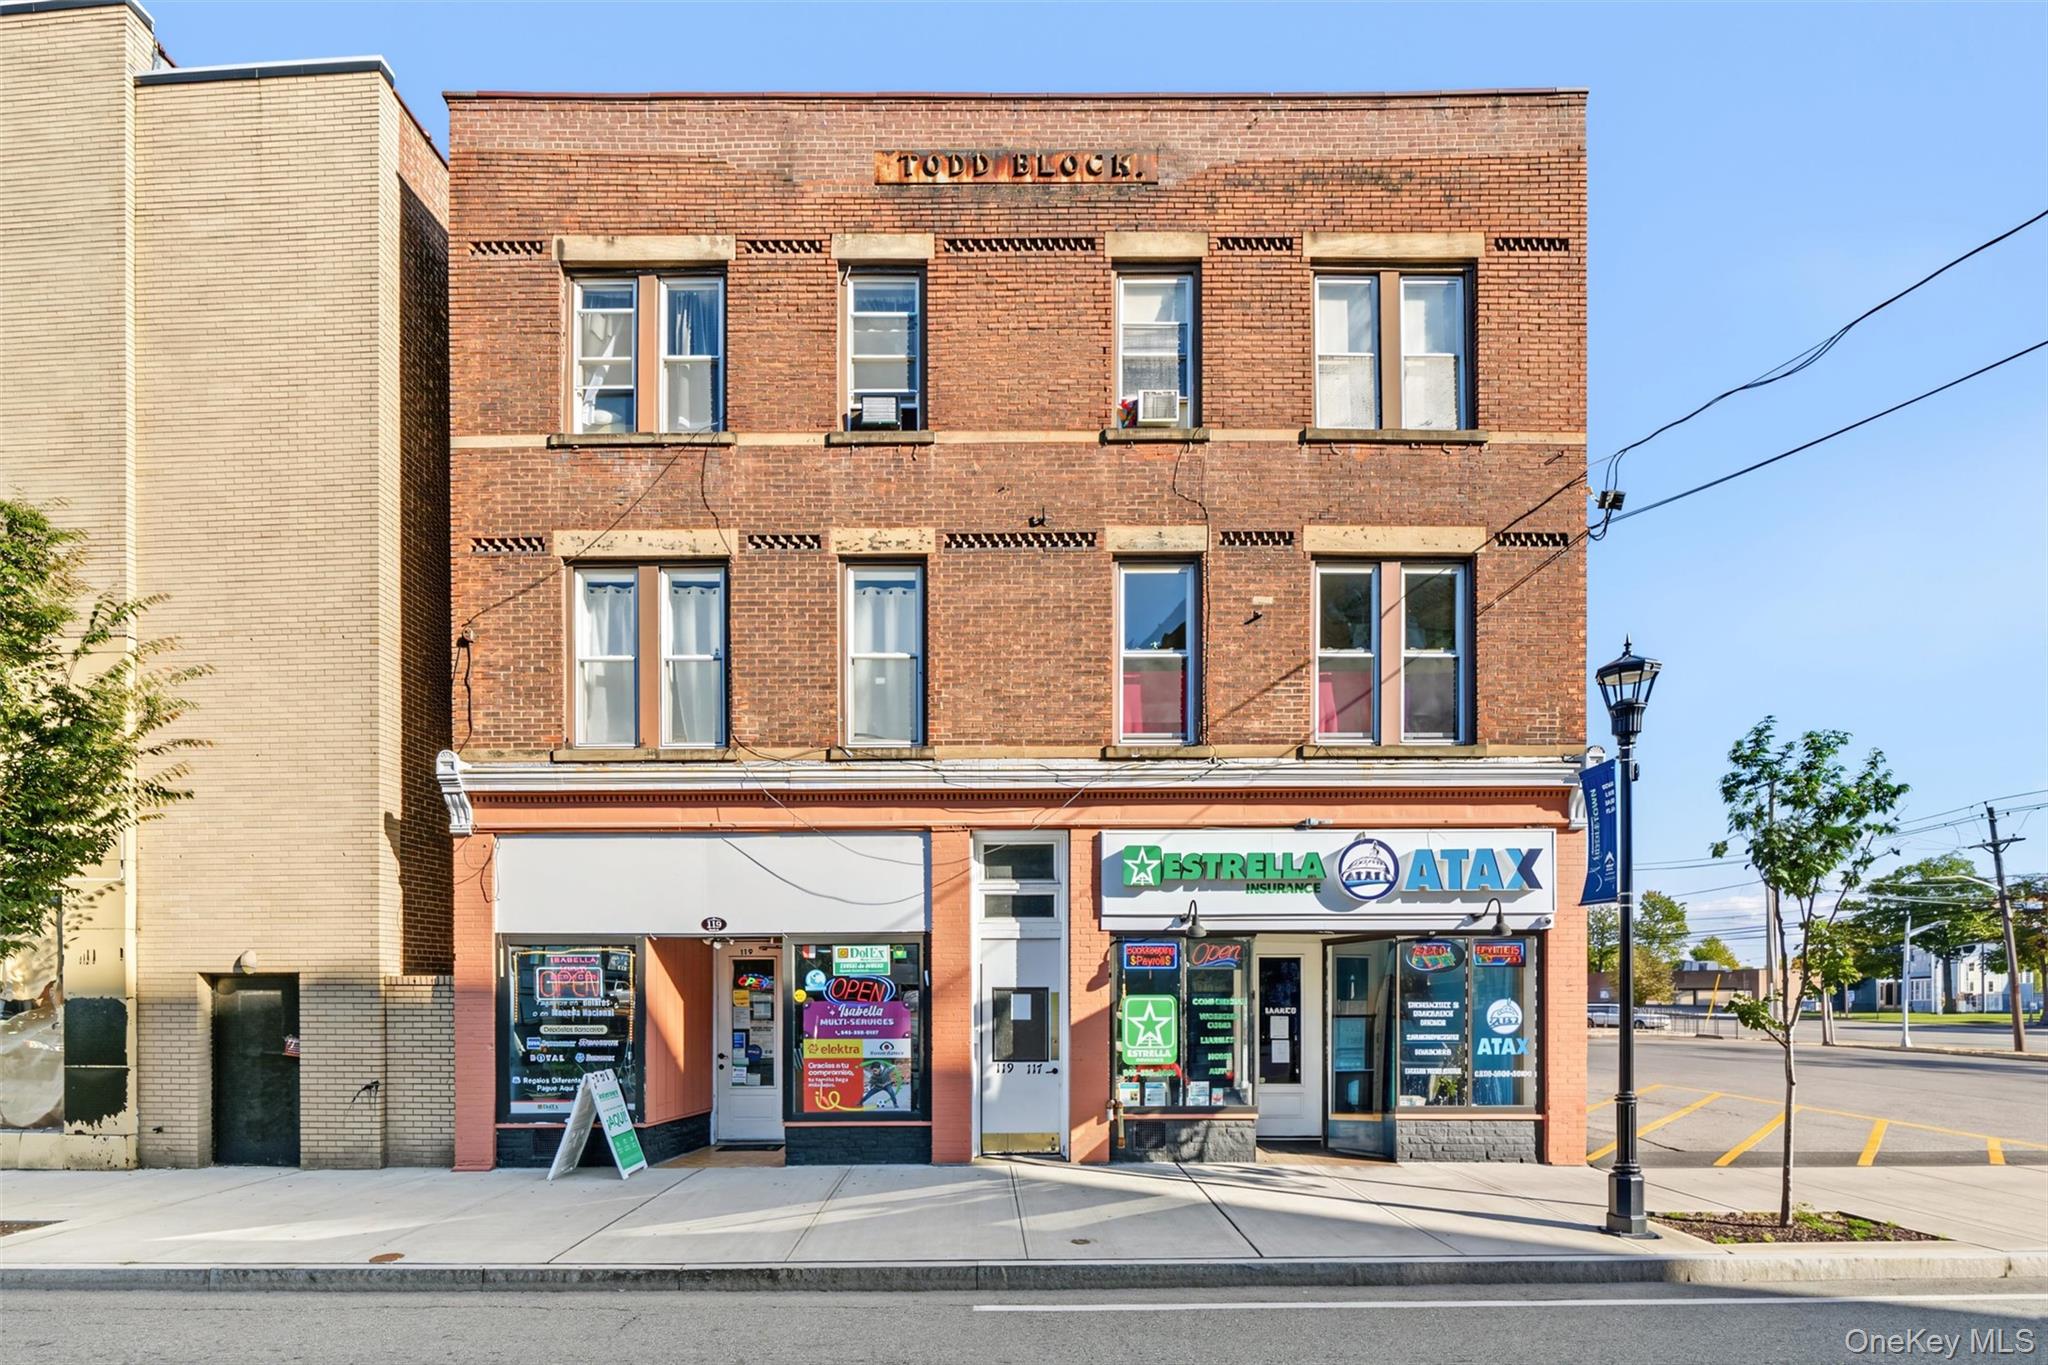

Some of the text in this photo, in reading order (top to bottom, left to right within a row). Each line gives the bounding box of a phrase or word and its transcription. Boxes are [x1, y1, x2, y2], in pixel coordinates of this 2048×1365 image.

[897, 153, 990, 177] TODD
[1161, 851, 1327, 880] ESTRELLA
[1406, 847, 1544, 891] ATAX
[1245, 882, 1321, 895] INSURANCE
[707, 919, 722, 929] 119
[850, 947, 885, 958] DolEx
[1191, 943, 1242, 966] Open
[540, 970, 599, 997] OPEN
[831, 977, 886, 1002] OPEN
[838, 1003, 884, 1017] Isabella
[819, 1018, 894, 1026] MULTI-SERVICES
[820, 1043, 860, 1055] elektra
[1476, 1037, 1529, 1055] ATAX
[1127, 1049, 1172, 1058] ESTRELLA
[996, 1063, 1042, 1075] 119 117
[523, 1076, 549, 1086] Regalos
